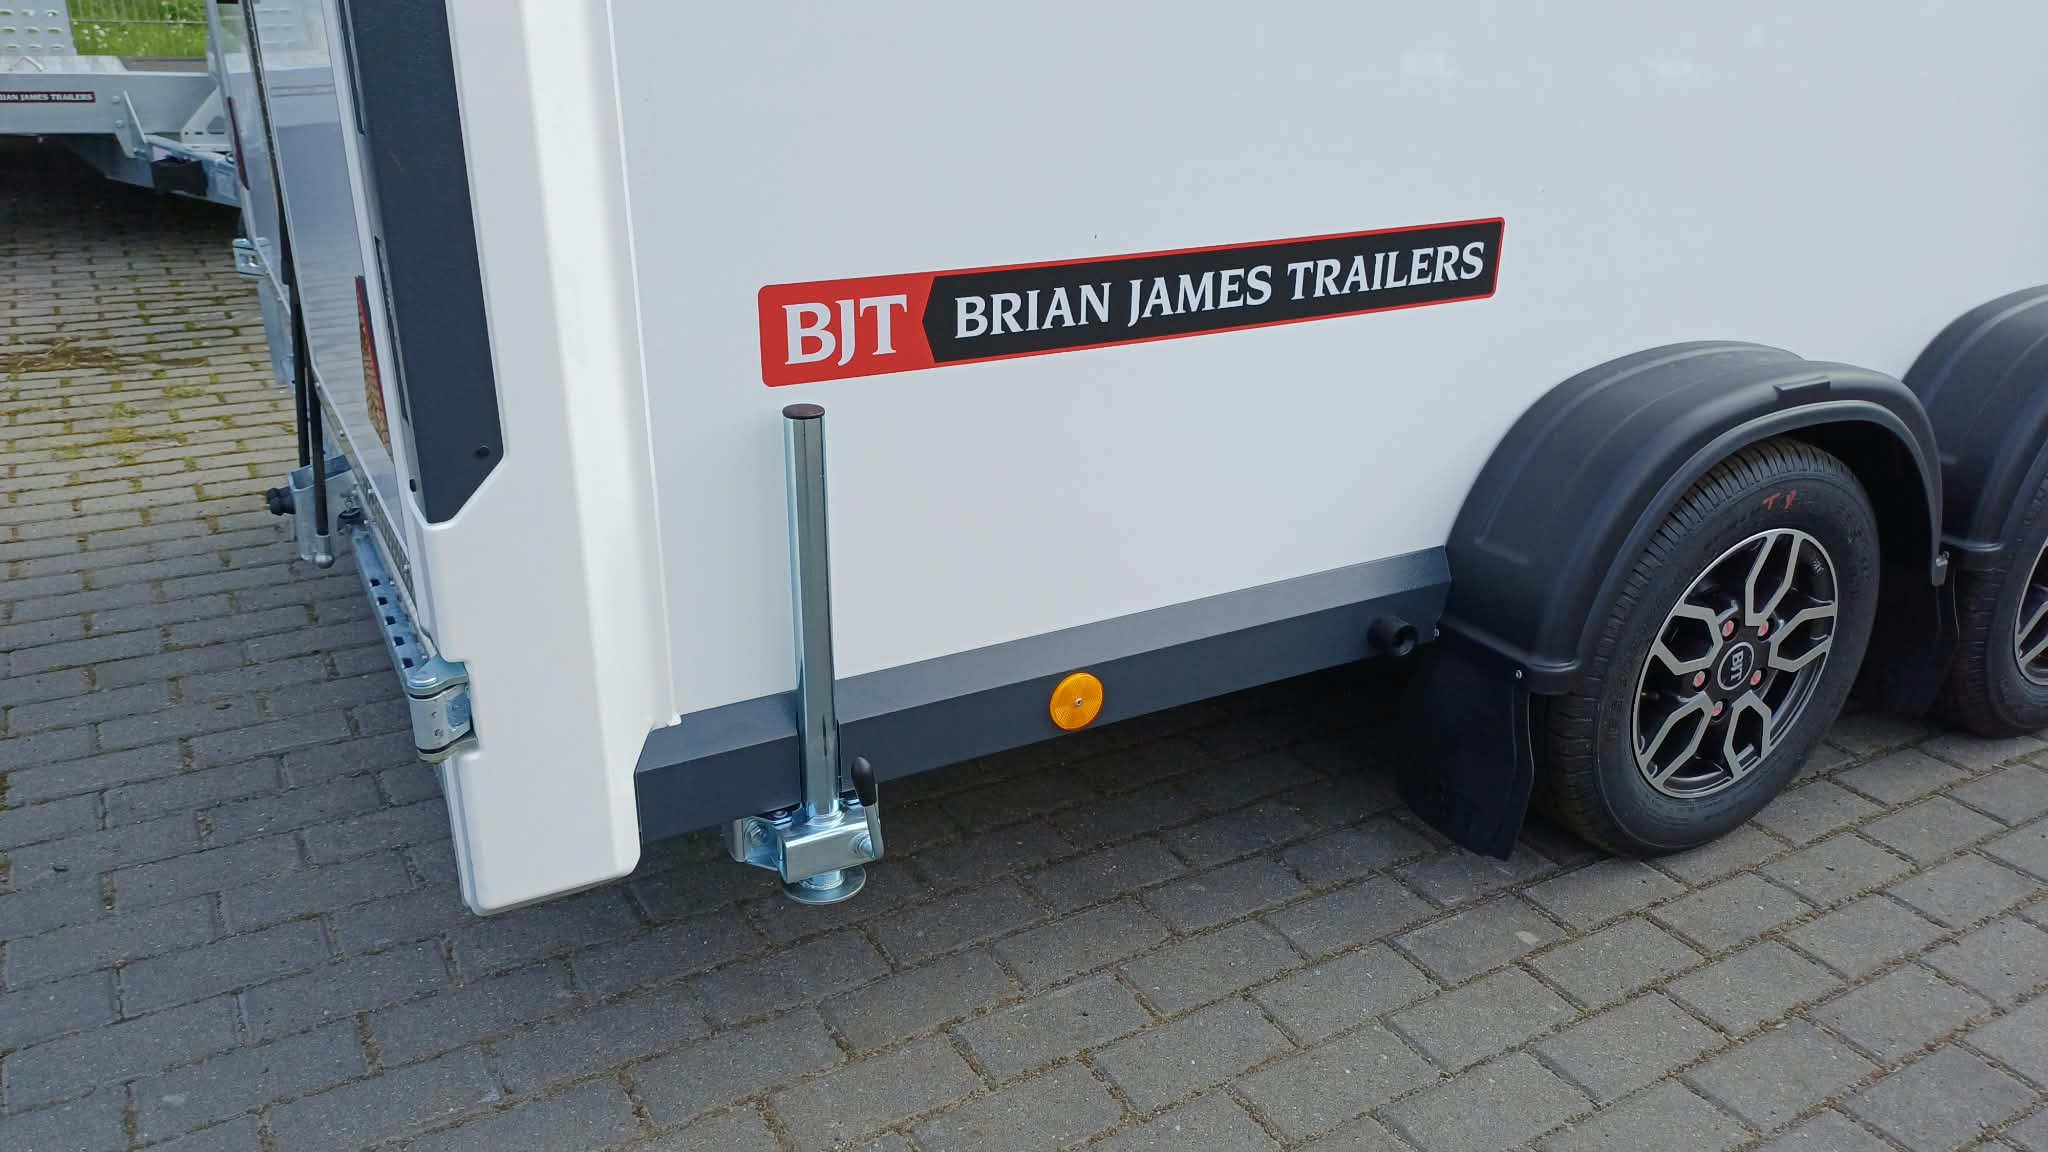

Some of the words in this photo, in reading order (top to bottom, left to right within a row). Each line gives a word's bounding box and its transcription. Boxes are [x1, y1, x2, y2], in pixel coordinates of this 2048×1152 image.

[20, 93, 49, 101] JAMES
[49, 93, 94, 101] TRAILERS
[782, 294, 908, 367] BJT
[954, 282, 1112, 339] BRIAN
[1127, 264, 1272, 328] JAMES
[1287, 241, 1485, 300] TRAILERS
[1730, 650, 1744, 681] BJT
